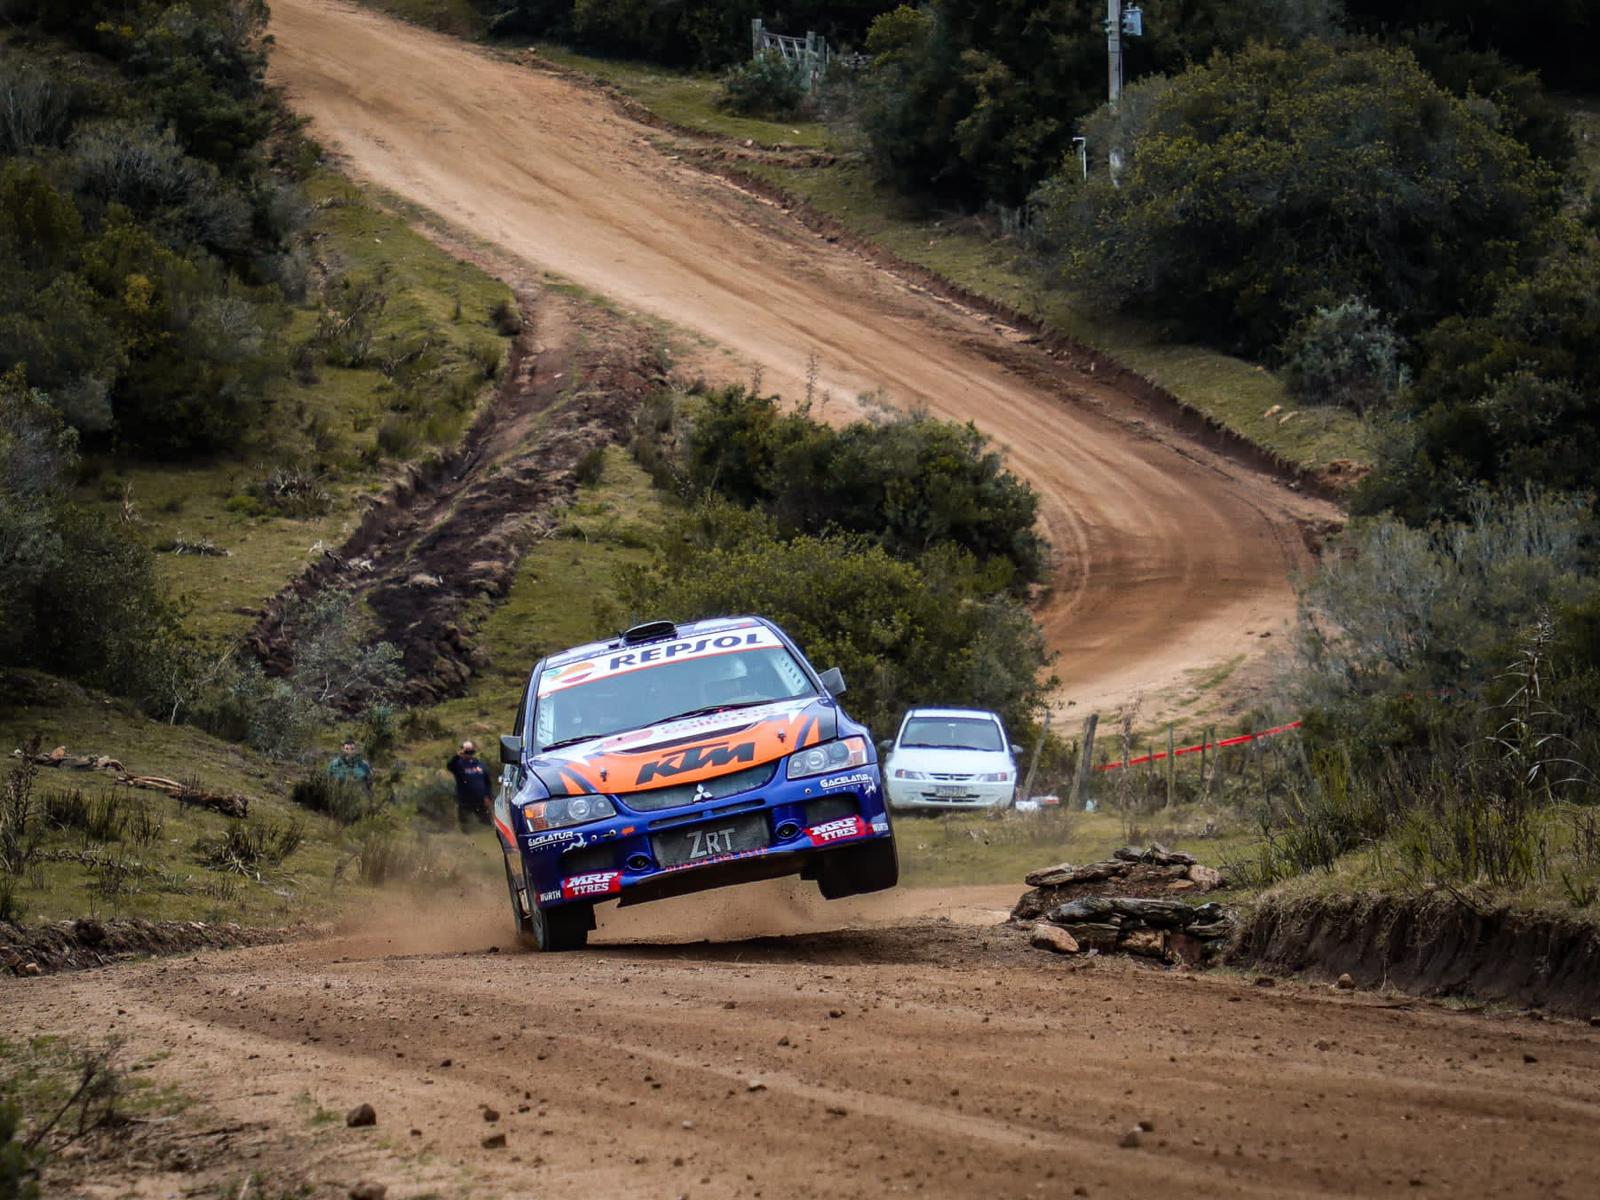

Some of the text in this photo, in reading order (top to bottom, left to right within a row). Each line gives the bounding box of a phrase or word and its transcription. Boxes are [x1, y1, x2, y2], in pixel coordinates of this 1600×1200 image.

[609, 633, 764, 670] REPSOL
[636, 741, 755, 785] KTM
[809, 817, 857, 835] MRF
[821, 826, 857, 841] TYRES
[686, 828, 736, 859] ZRT
[566, 872, 618, 888] MRF
[573, 883, 609, 895] TYRES
